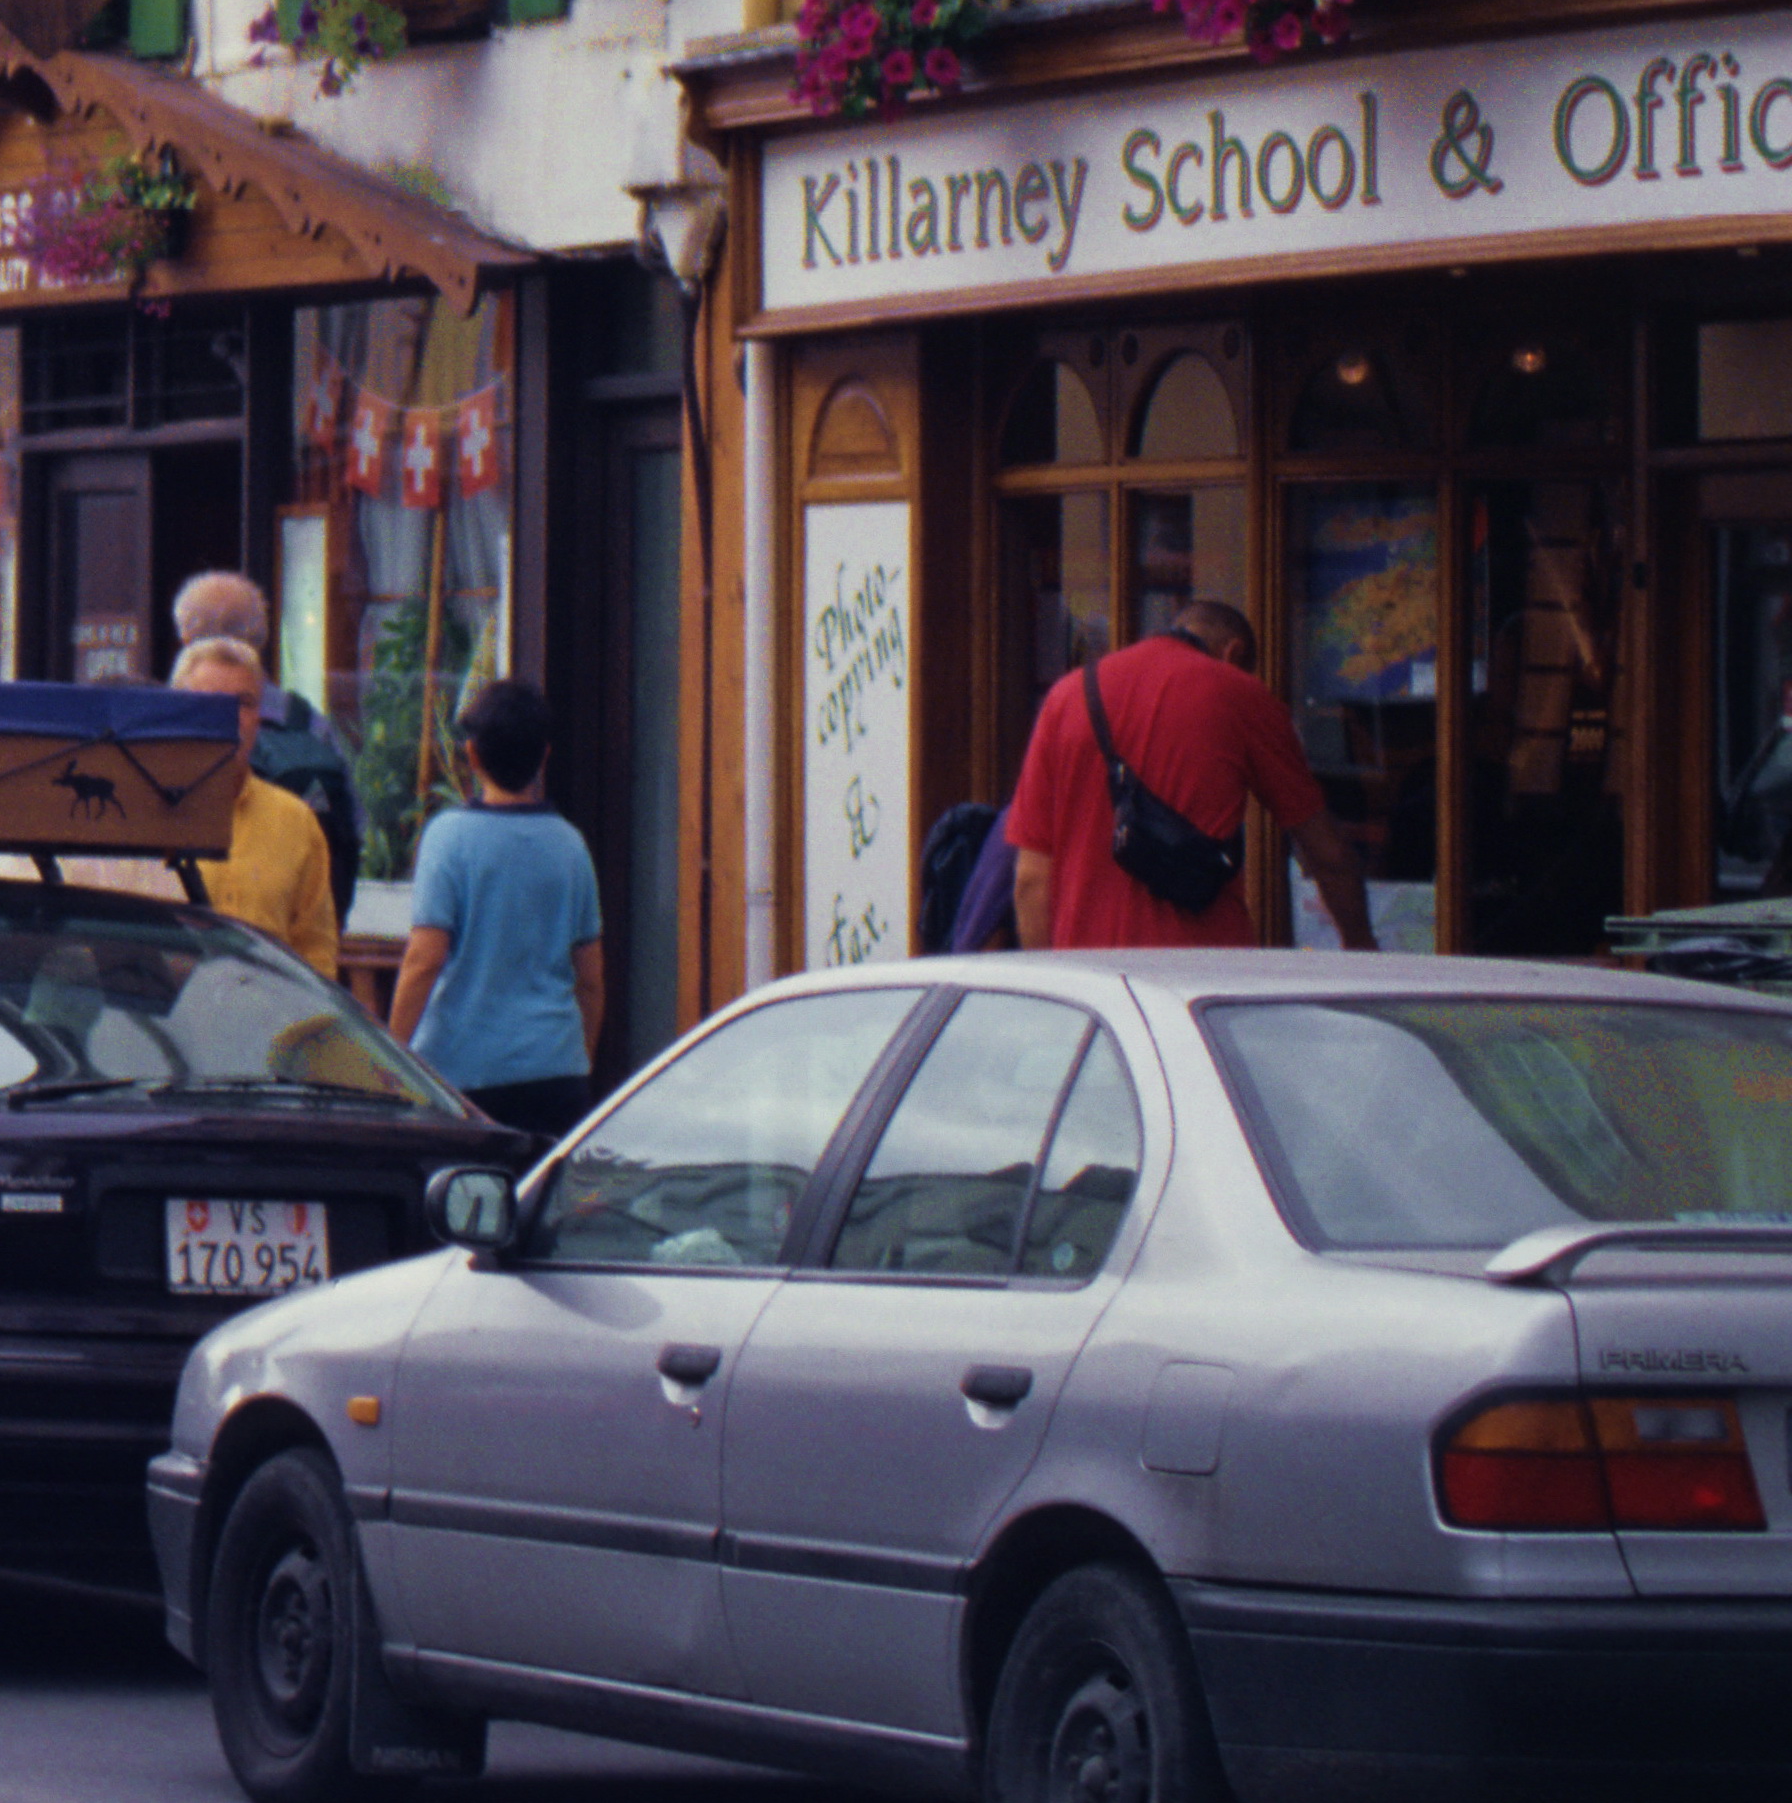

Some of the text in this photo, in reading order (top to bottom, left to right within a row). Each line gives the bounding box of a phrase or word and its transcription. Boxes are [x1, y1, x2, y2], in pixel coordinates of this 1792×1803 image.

[801, 155, 1088, 272] Killarney
[1120, 91, 1383, 232] School
[1428, 88, 1504, 201] &
[226, 1202, 267, 1234] VS
[176, 1243, 322, 1287] 170 954
